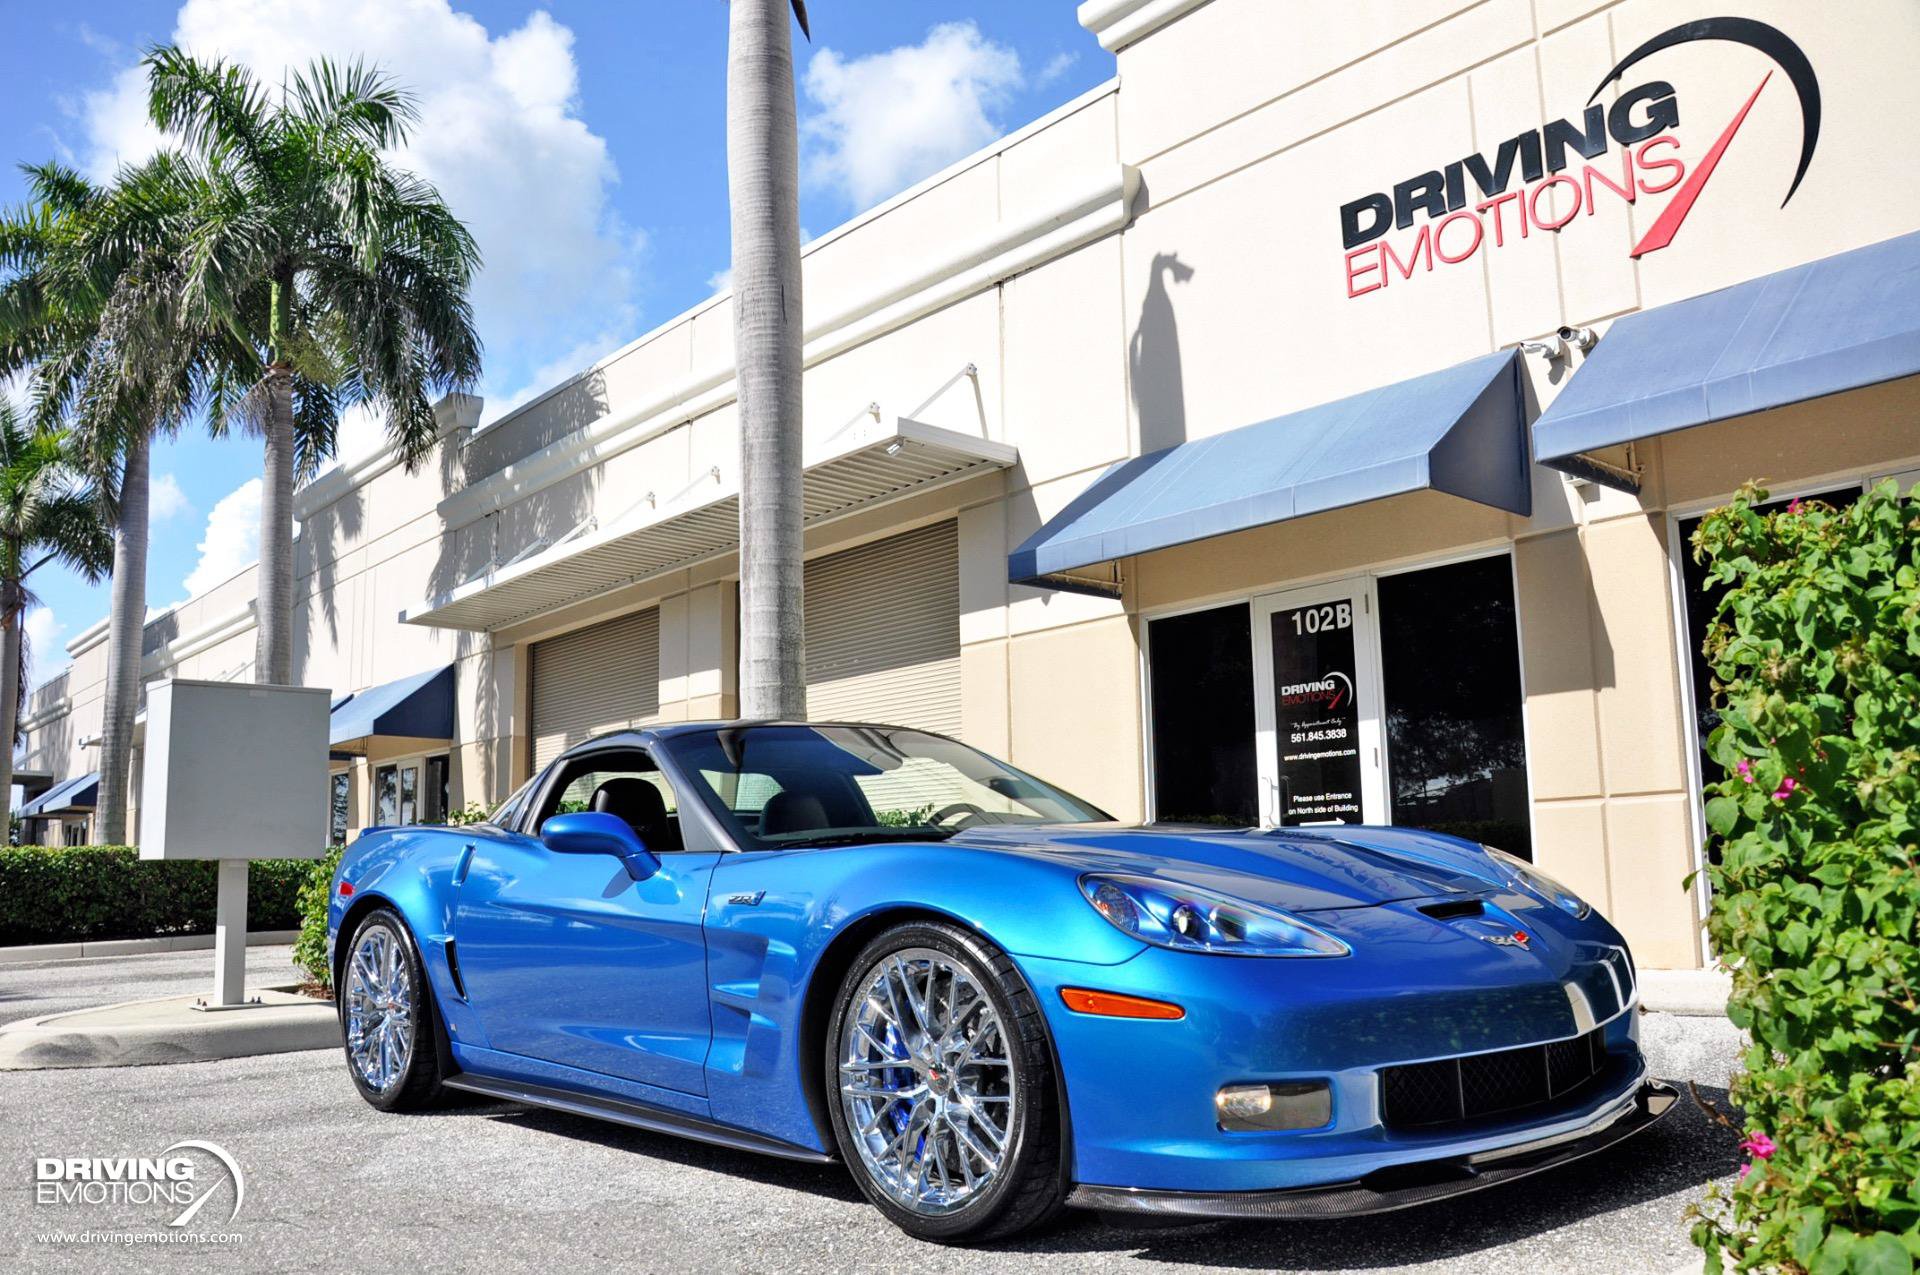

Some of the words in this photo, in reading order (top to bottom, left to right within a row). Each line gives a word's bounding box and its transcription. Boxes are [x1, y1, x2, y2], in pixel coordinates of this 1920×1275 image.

[1340, 80, 1680, 249] DRIVING
[1345, 135, 1685, 299] EMOTIONS
[1291, 603, 1352, 635] 102B
[1281, 680, 1336, 696] DRIVING
[1282, 689, 1337, 705] EMOTIONS
[1290, 728, 1347, 743] 561.845.3838
[1284, 748, 1357, 761] www.drivingemotions.com
[1293, 794, 1313, 803] Please
[1325, 792, 1352, 801] Entrance
[1297, 806, 1314, 815] North
[1314, 805, 1327, 814] side
[1327, 804, 1334, 813] of
[1334, 803, 1359, 813] Building
